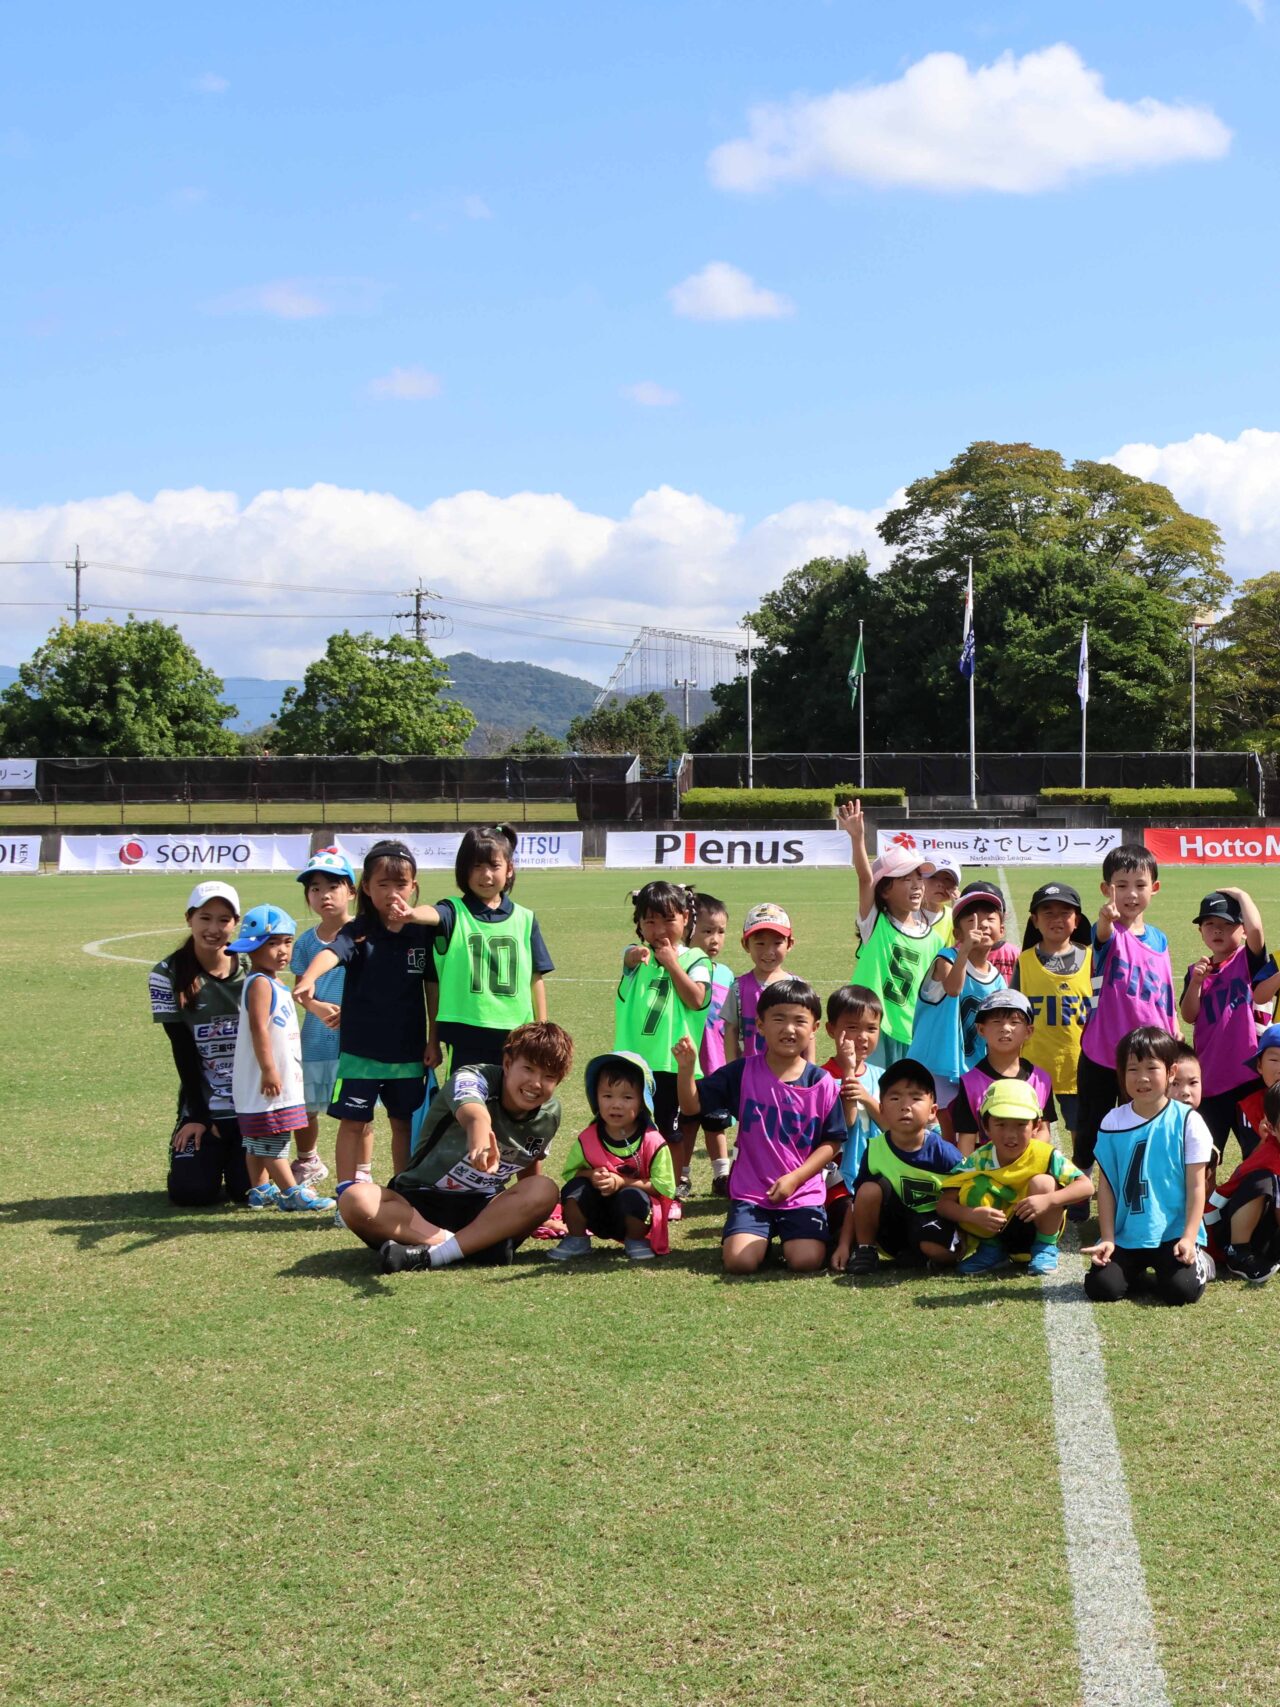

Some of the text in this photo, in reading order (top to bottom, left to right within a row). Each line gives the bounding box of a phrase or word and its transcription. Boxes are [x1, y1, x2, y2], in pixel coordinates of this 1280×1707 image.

[156, 844, 250, 864] SOMPO
[655, 832, 804, 864] Plenus
[923, 839, 969, 850] Plenus
[973, 835, 1115, 853] なでしこリーグ
[467, 932, 519, 997] 10
[882, 943, 922, 1009] 5
[1122, 1140, 1150, 1215] 4
